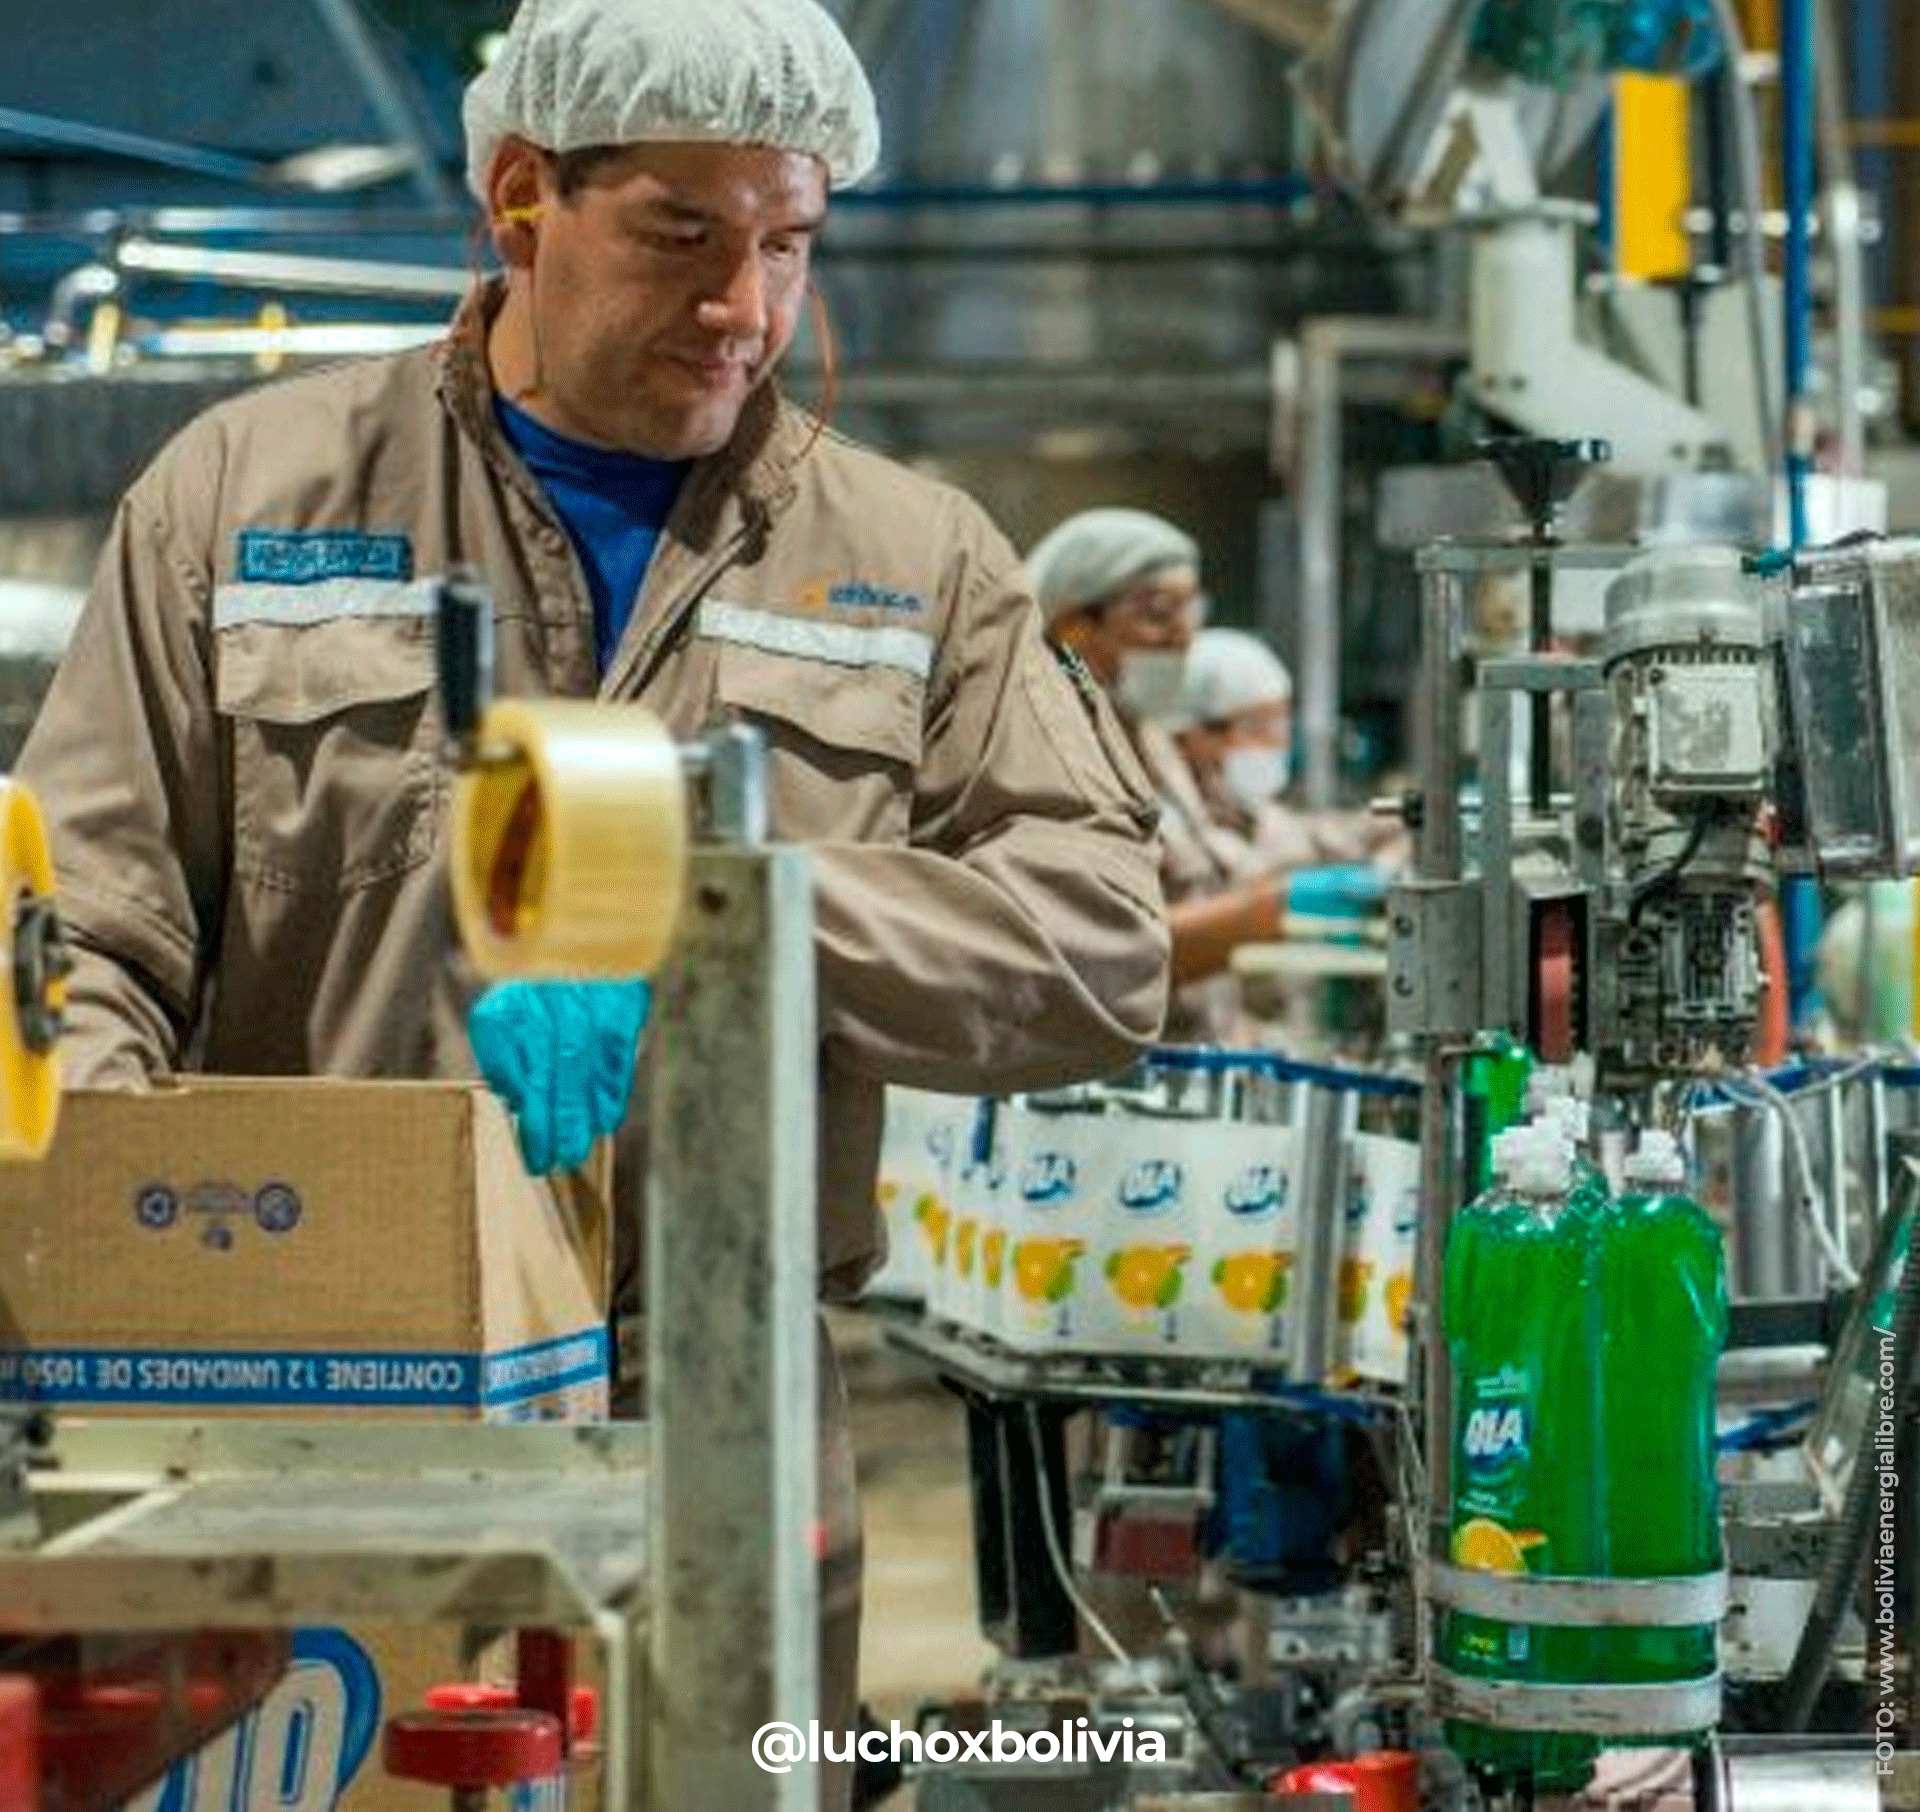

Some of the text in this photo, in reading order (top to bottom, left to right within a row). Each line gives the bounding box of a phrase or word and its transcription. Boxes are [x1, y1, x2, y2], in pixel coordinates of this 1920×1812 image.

[96, 1358, 132, 1390] DE
[138, 1358, 280, 1390] UNIDADES
[286, 1358, 317, 1390] 12
[326, 1359, 464, 1391] CONTIENE
